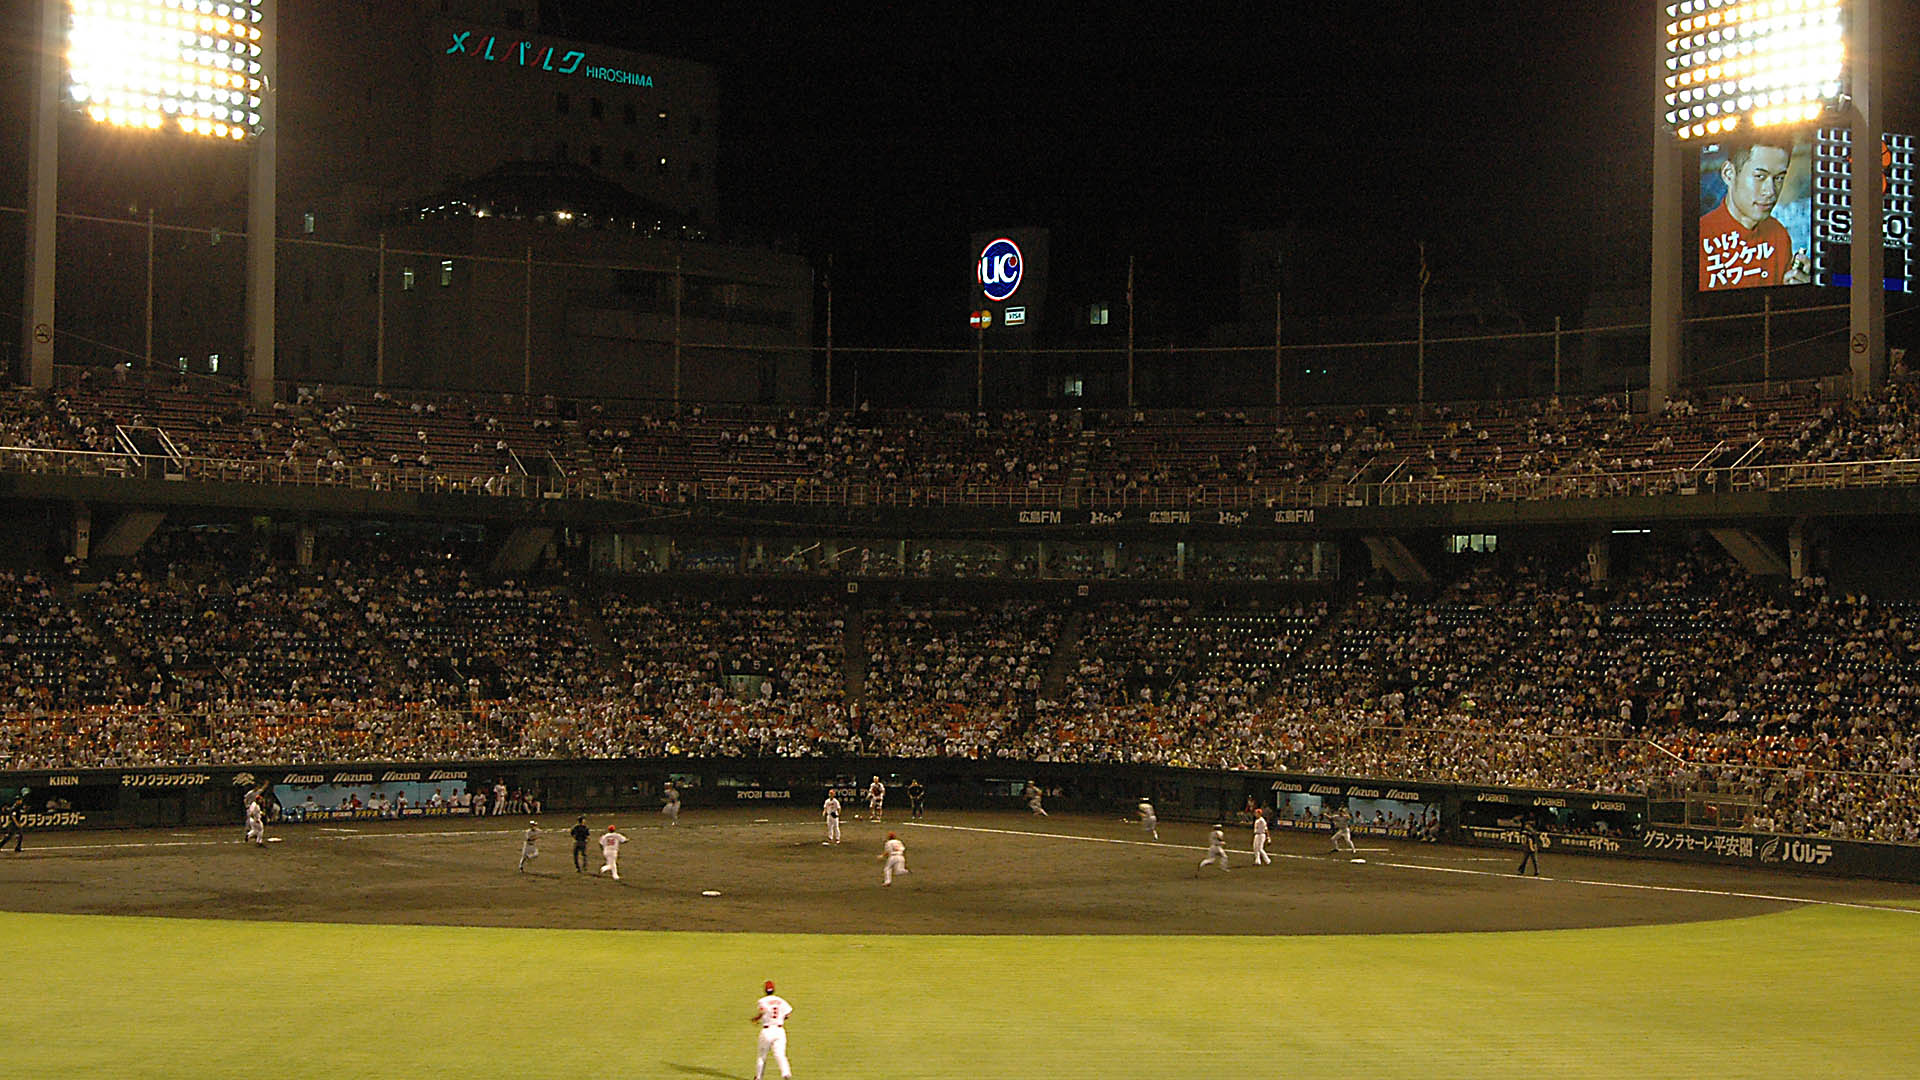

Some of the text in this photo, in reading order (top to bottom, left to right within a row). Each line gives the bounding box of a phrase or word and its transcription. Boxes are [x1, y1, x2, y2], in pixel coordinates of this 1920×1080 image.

[447, 31, 654, 88] メルパルク HIROSHIMA
[1707, 242, 1775, 271] ユンケル
[1708, 266, 1768, 288] パワー。
[49, 776, 79, 786] KIRIN
[737, 790, 762, 799] RYOBI
[1782, 841, 1832, 864] パルテ
